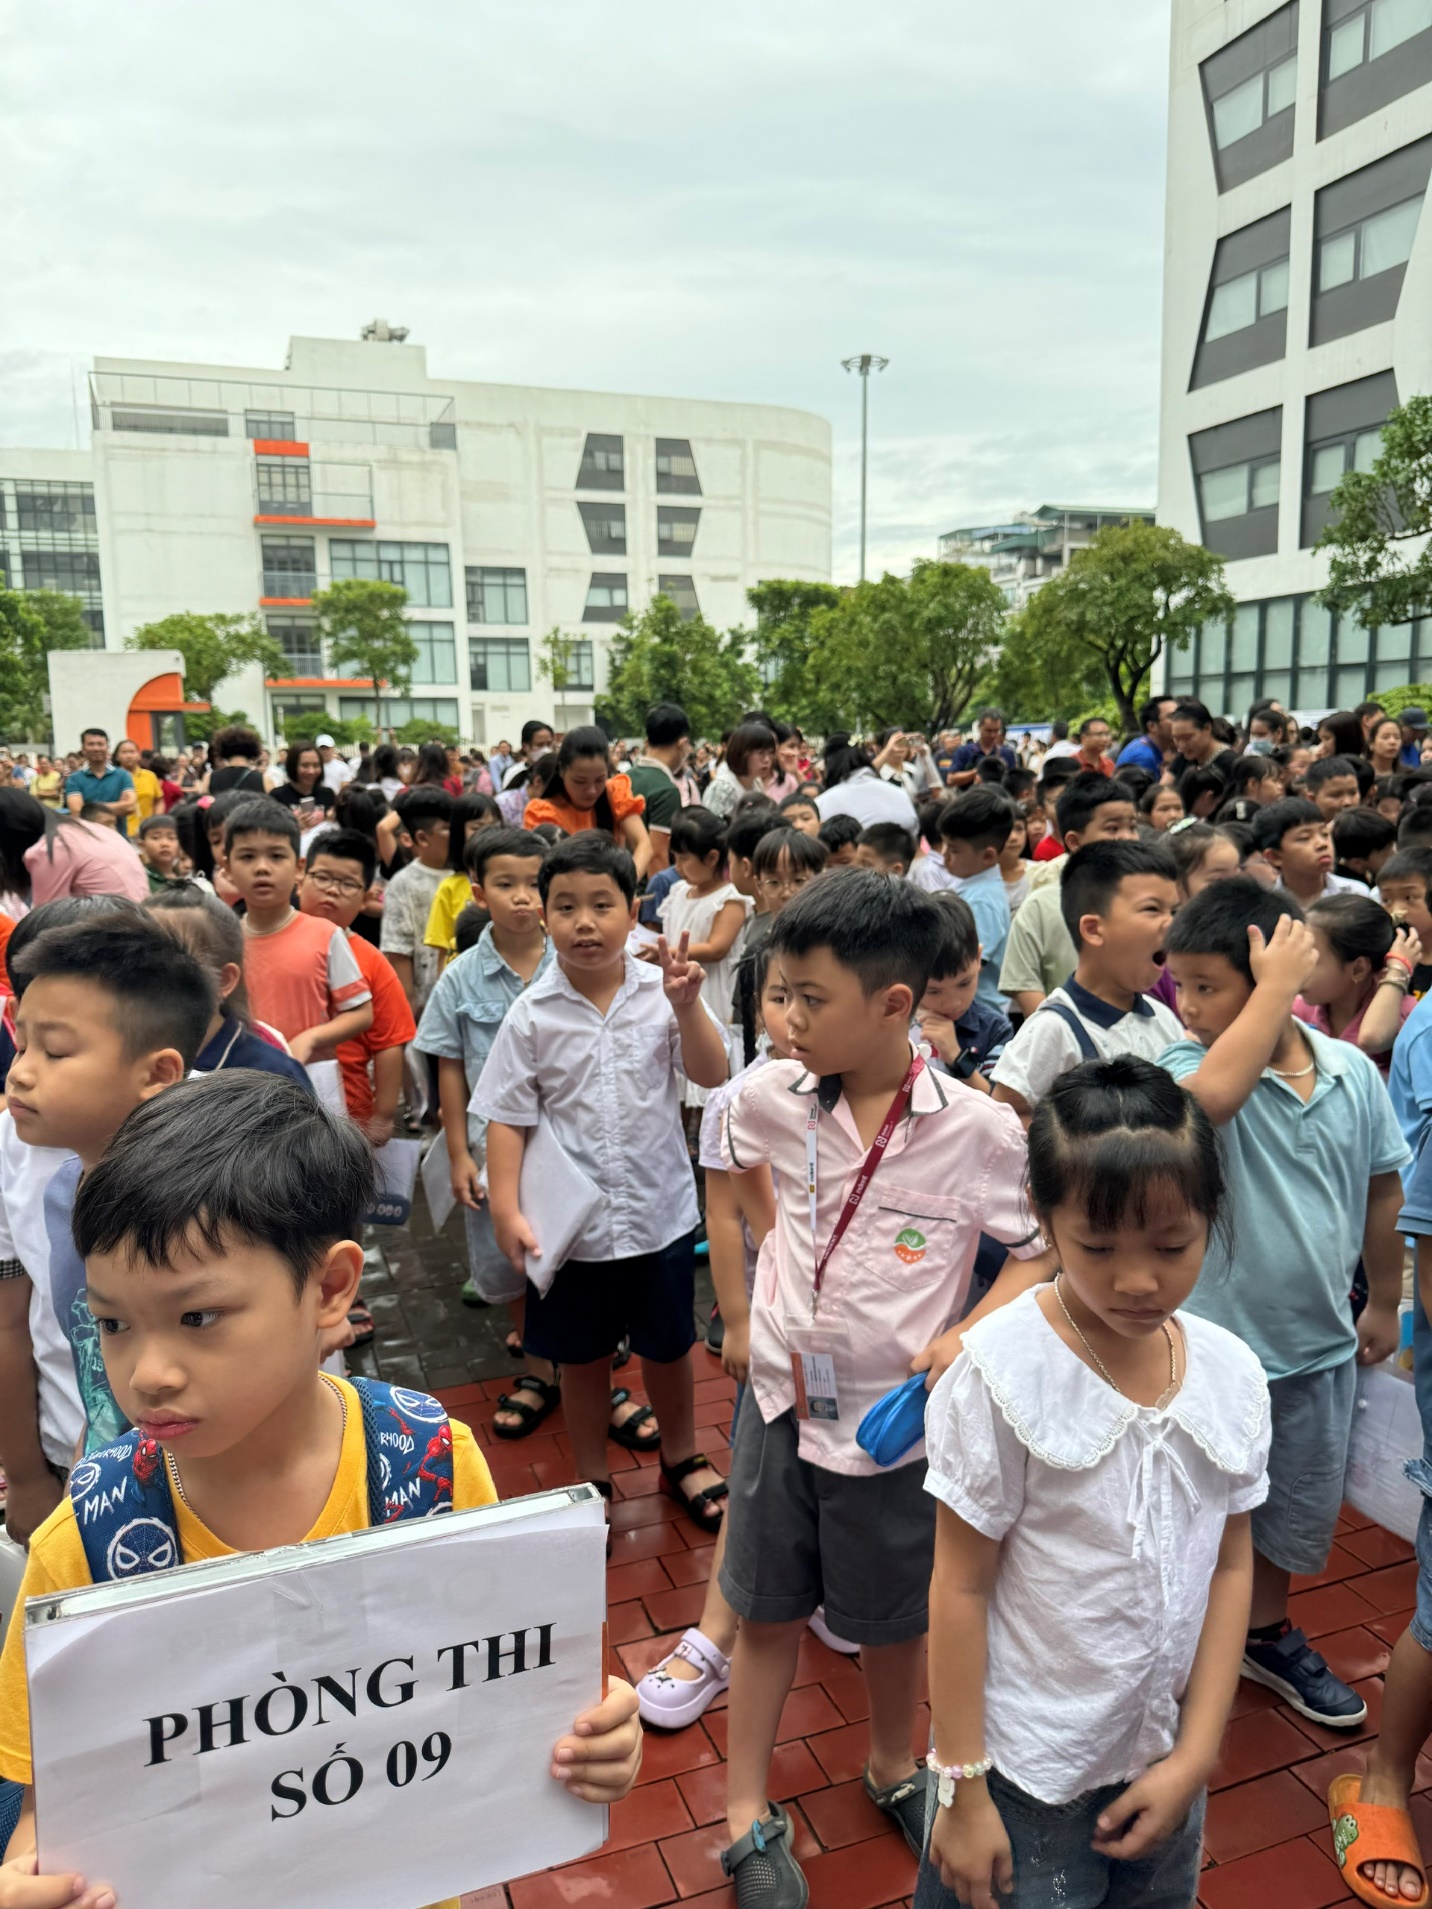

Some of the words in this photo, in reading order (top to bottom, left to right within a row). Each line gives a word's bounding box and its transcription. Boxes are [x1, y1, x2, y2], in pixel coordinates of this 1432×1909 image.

[83, 1475, 128, 1526] MAN
[143, 1655, 419, 1767] PHÒNG
[437, 1622, 558, 1691] THI
[271, 1741, 364, 1822] SỐ
[386, 1731, 453, 1788] 09
